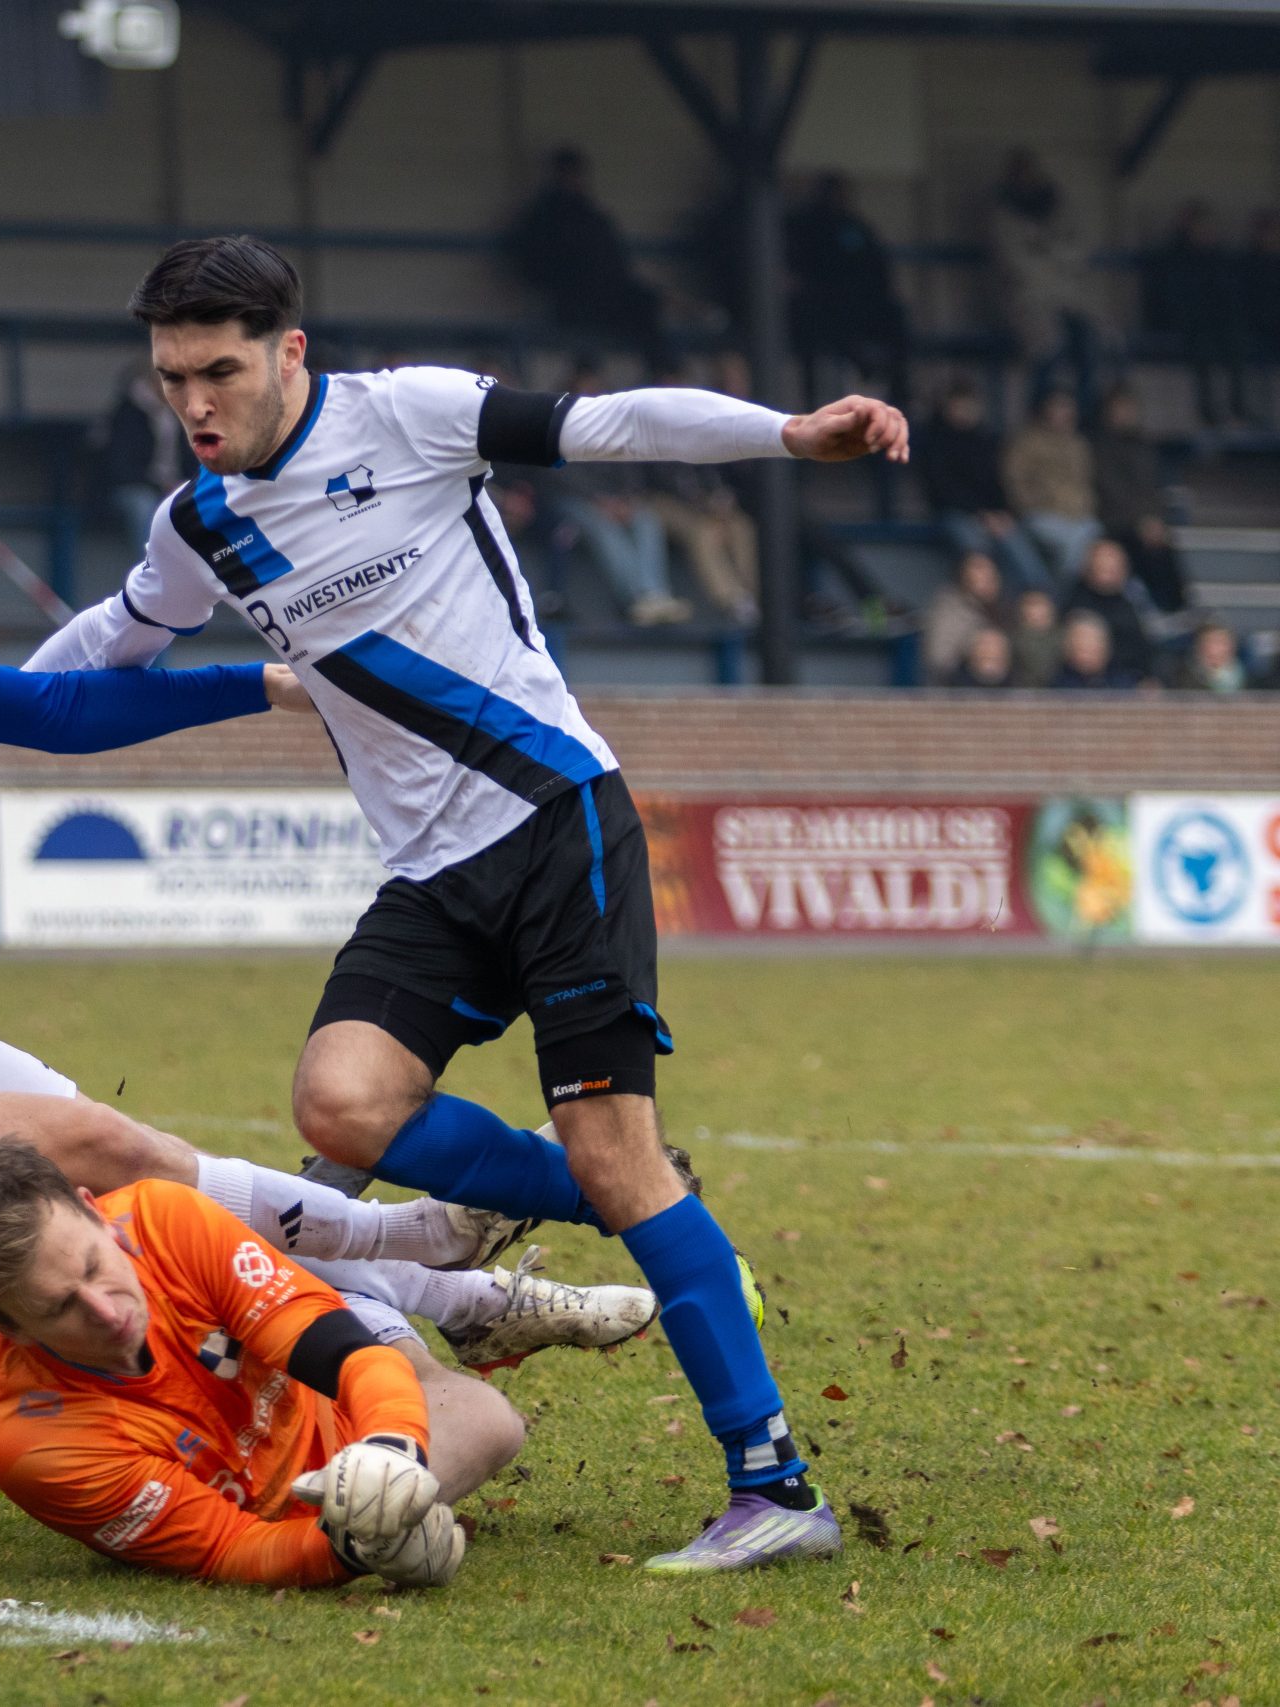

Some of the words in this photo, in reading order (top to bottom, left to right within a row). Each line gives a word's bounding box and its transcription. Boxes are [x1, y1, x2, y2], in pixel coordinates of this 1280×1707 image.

[212, 533, 255, 563] STANNO
[283, 547, 422, 625] INVESTMENTS
[715, 808, 1009, 848] STEAKHOUSE
[719, 861, 1012, 930] VIVALDI
[544, 979, 608, 1007] STANNO
